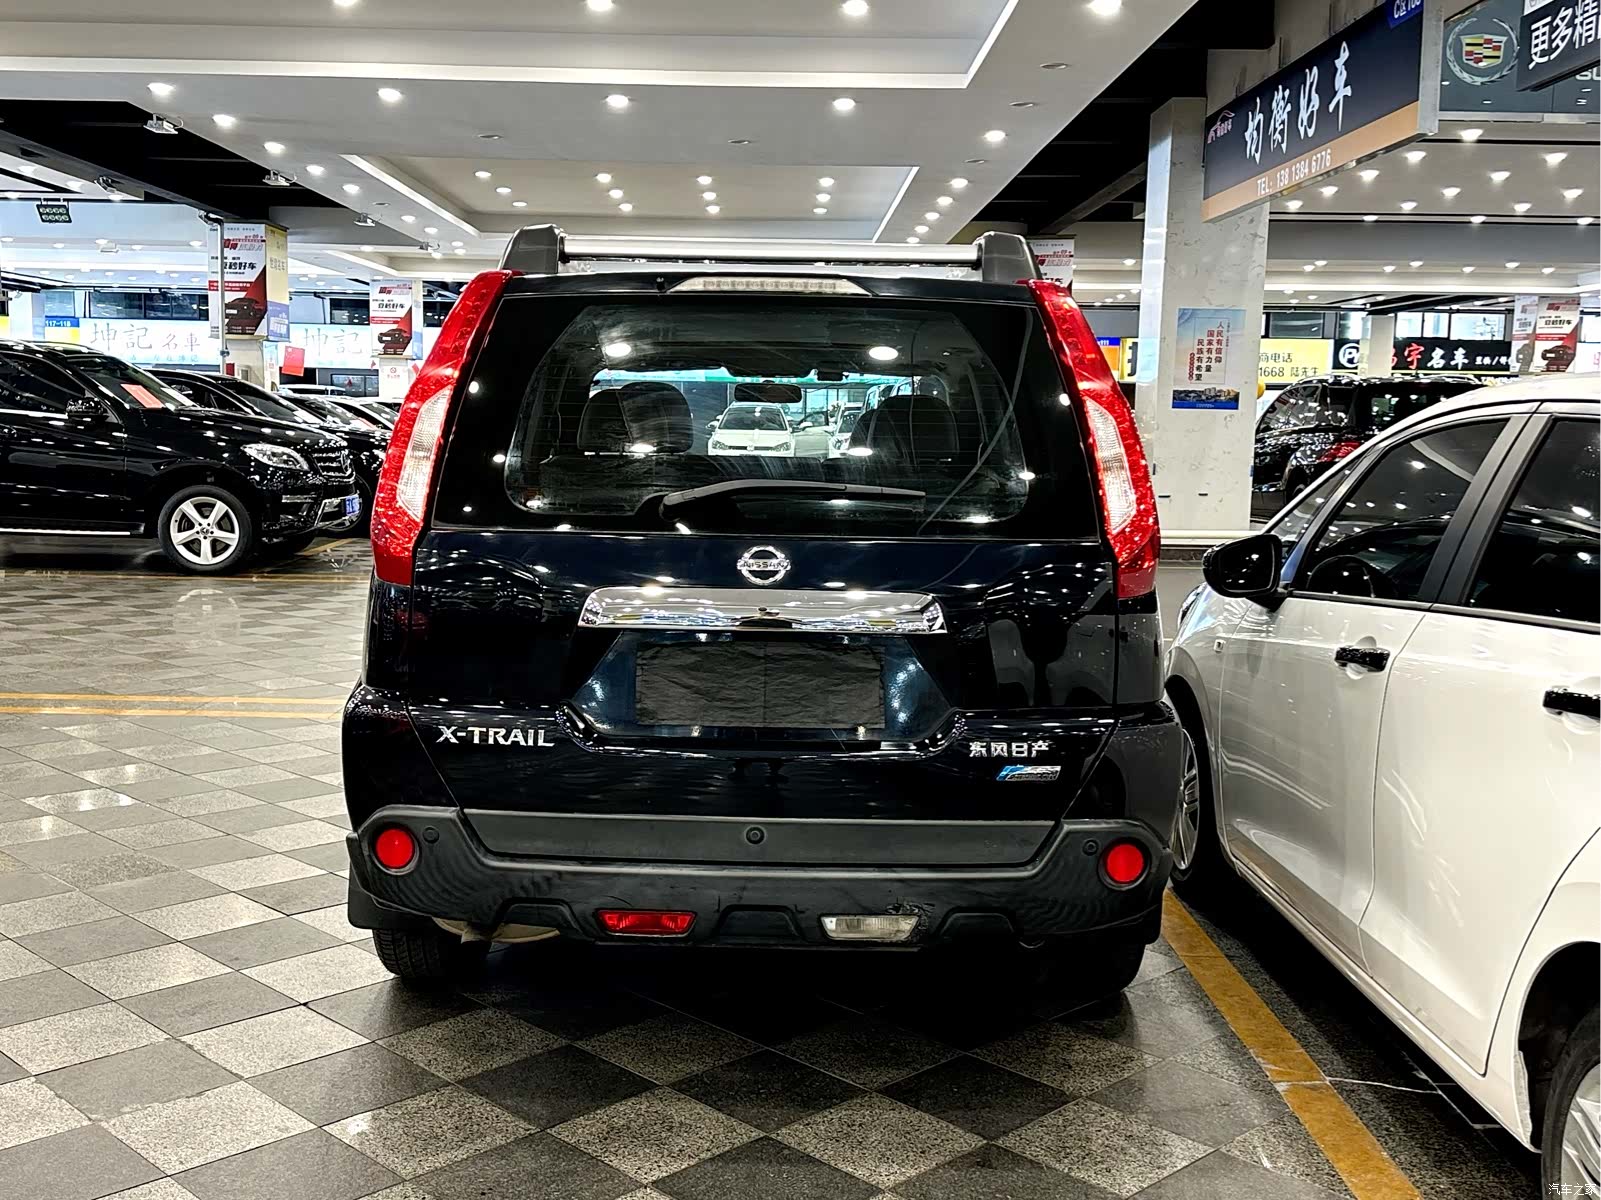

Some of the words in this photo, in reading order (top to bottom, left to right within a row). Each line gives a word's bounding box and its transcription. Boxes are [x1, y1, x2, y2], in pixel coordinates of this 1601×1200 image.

[1276, 168, 1289, 188] 138
[1292, 159, 1310, 182] 1384
[1312, 148, 1331, 173] 6776
[1195, 339, 1205, 381] 民族有希望
[1205, 330, 1215, 373] 国家有力量
[1214, 321, 1225, 364] 人民有信仰
[741, 560, 788, 570] NISSAN
[436, 725, 555, 747] X-TRAIL
[969, 740, 1049, 757] 东风日产
